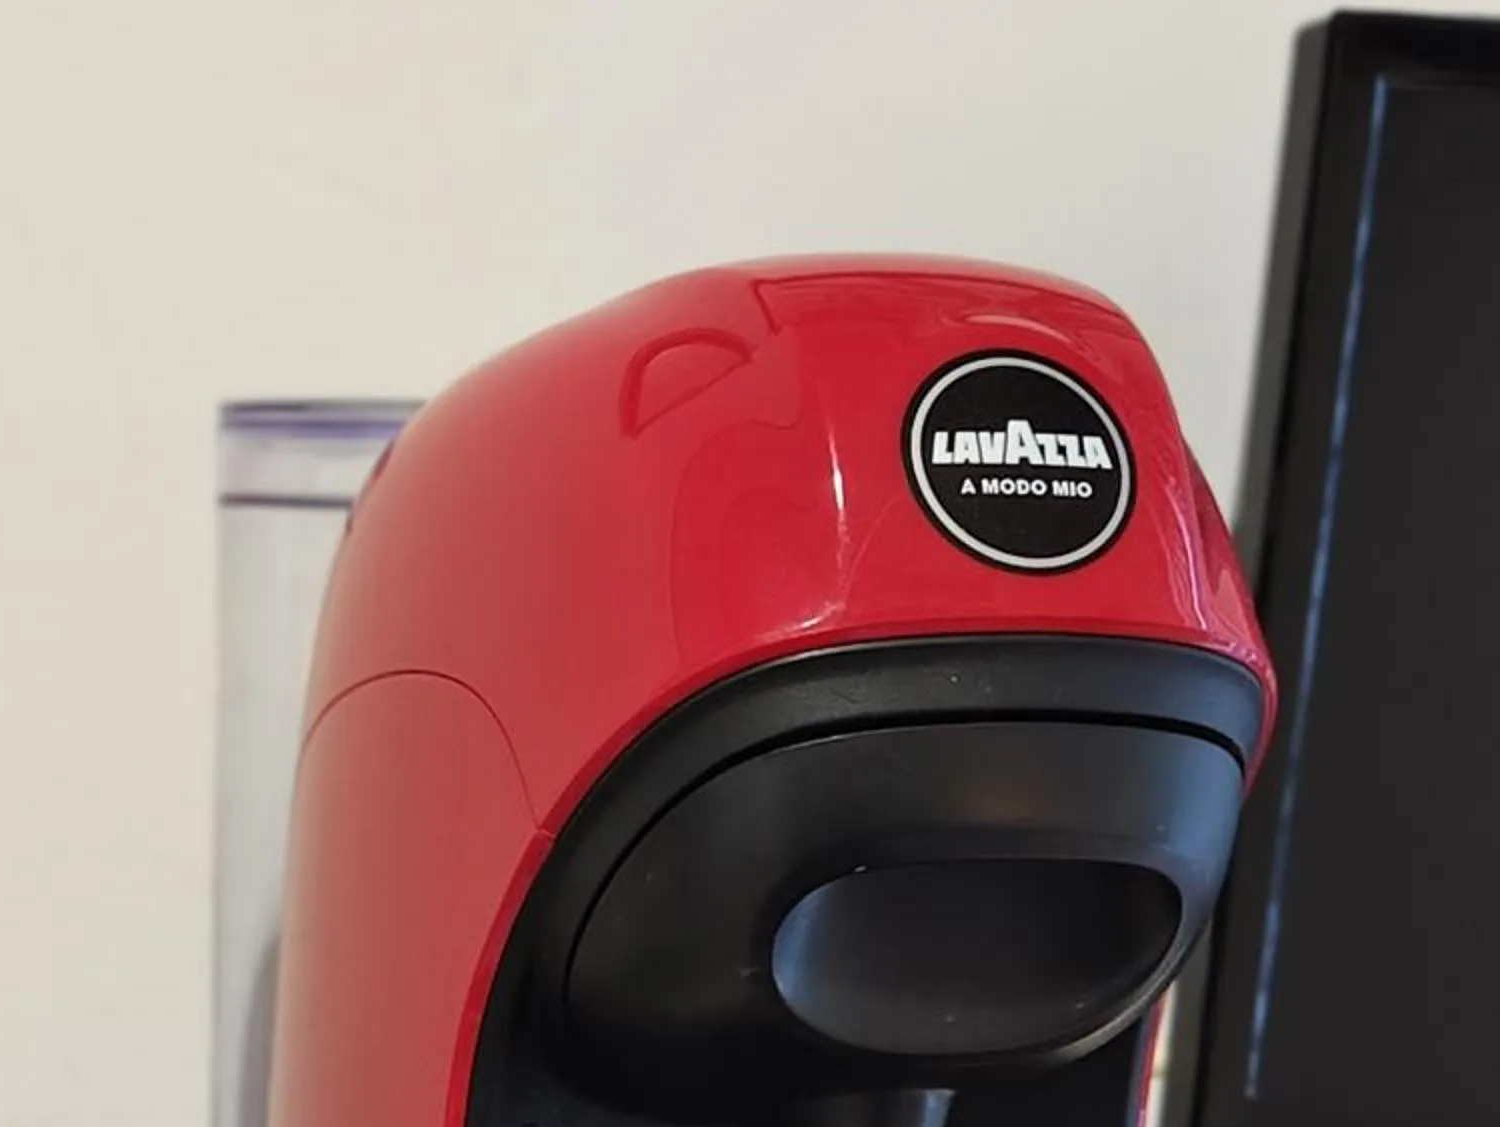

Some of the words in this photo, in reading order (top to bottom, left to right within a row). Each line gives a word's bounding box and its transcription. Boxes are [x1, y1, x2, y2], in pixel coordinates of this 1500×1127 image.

[932, 419, 1113, 469] LAVAZZA
[960, 478, 976, 494] A
[981, 478, 1047, 496] MODO
[1052, 480, 1093, 499] MIO
